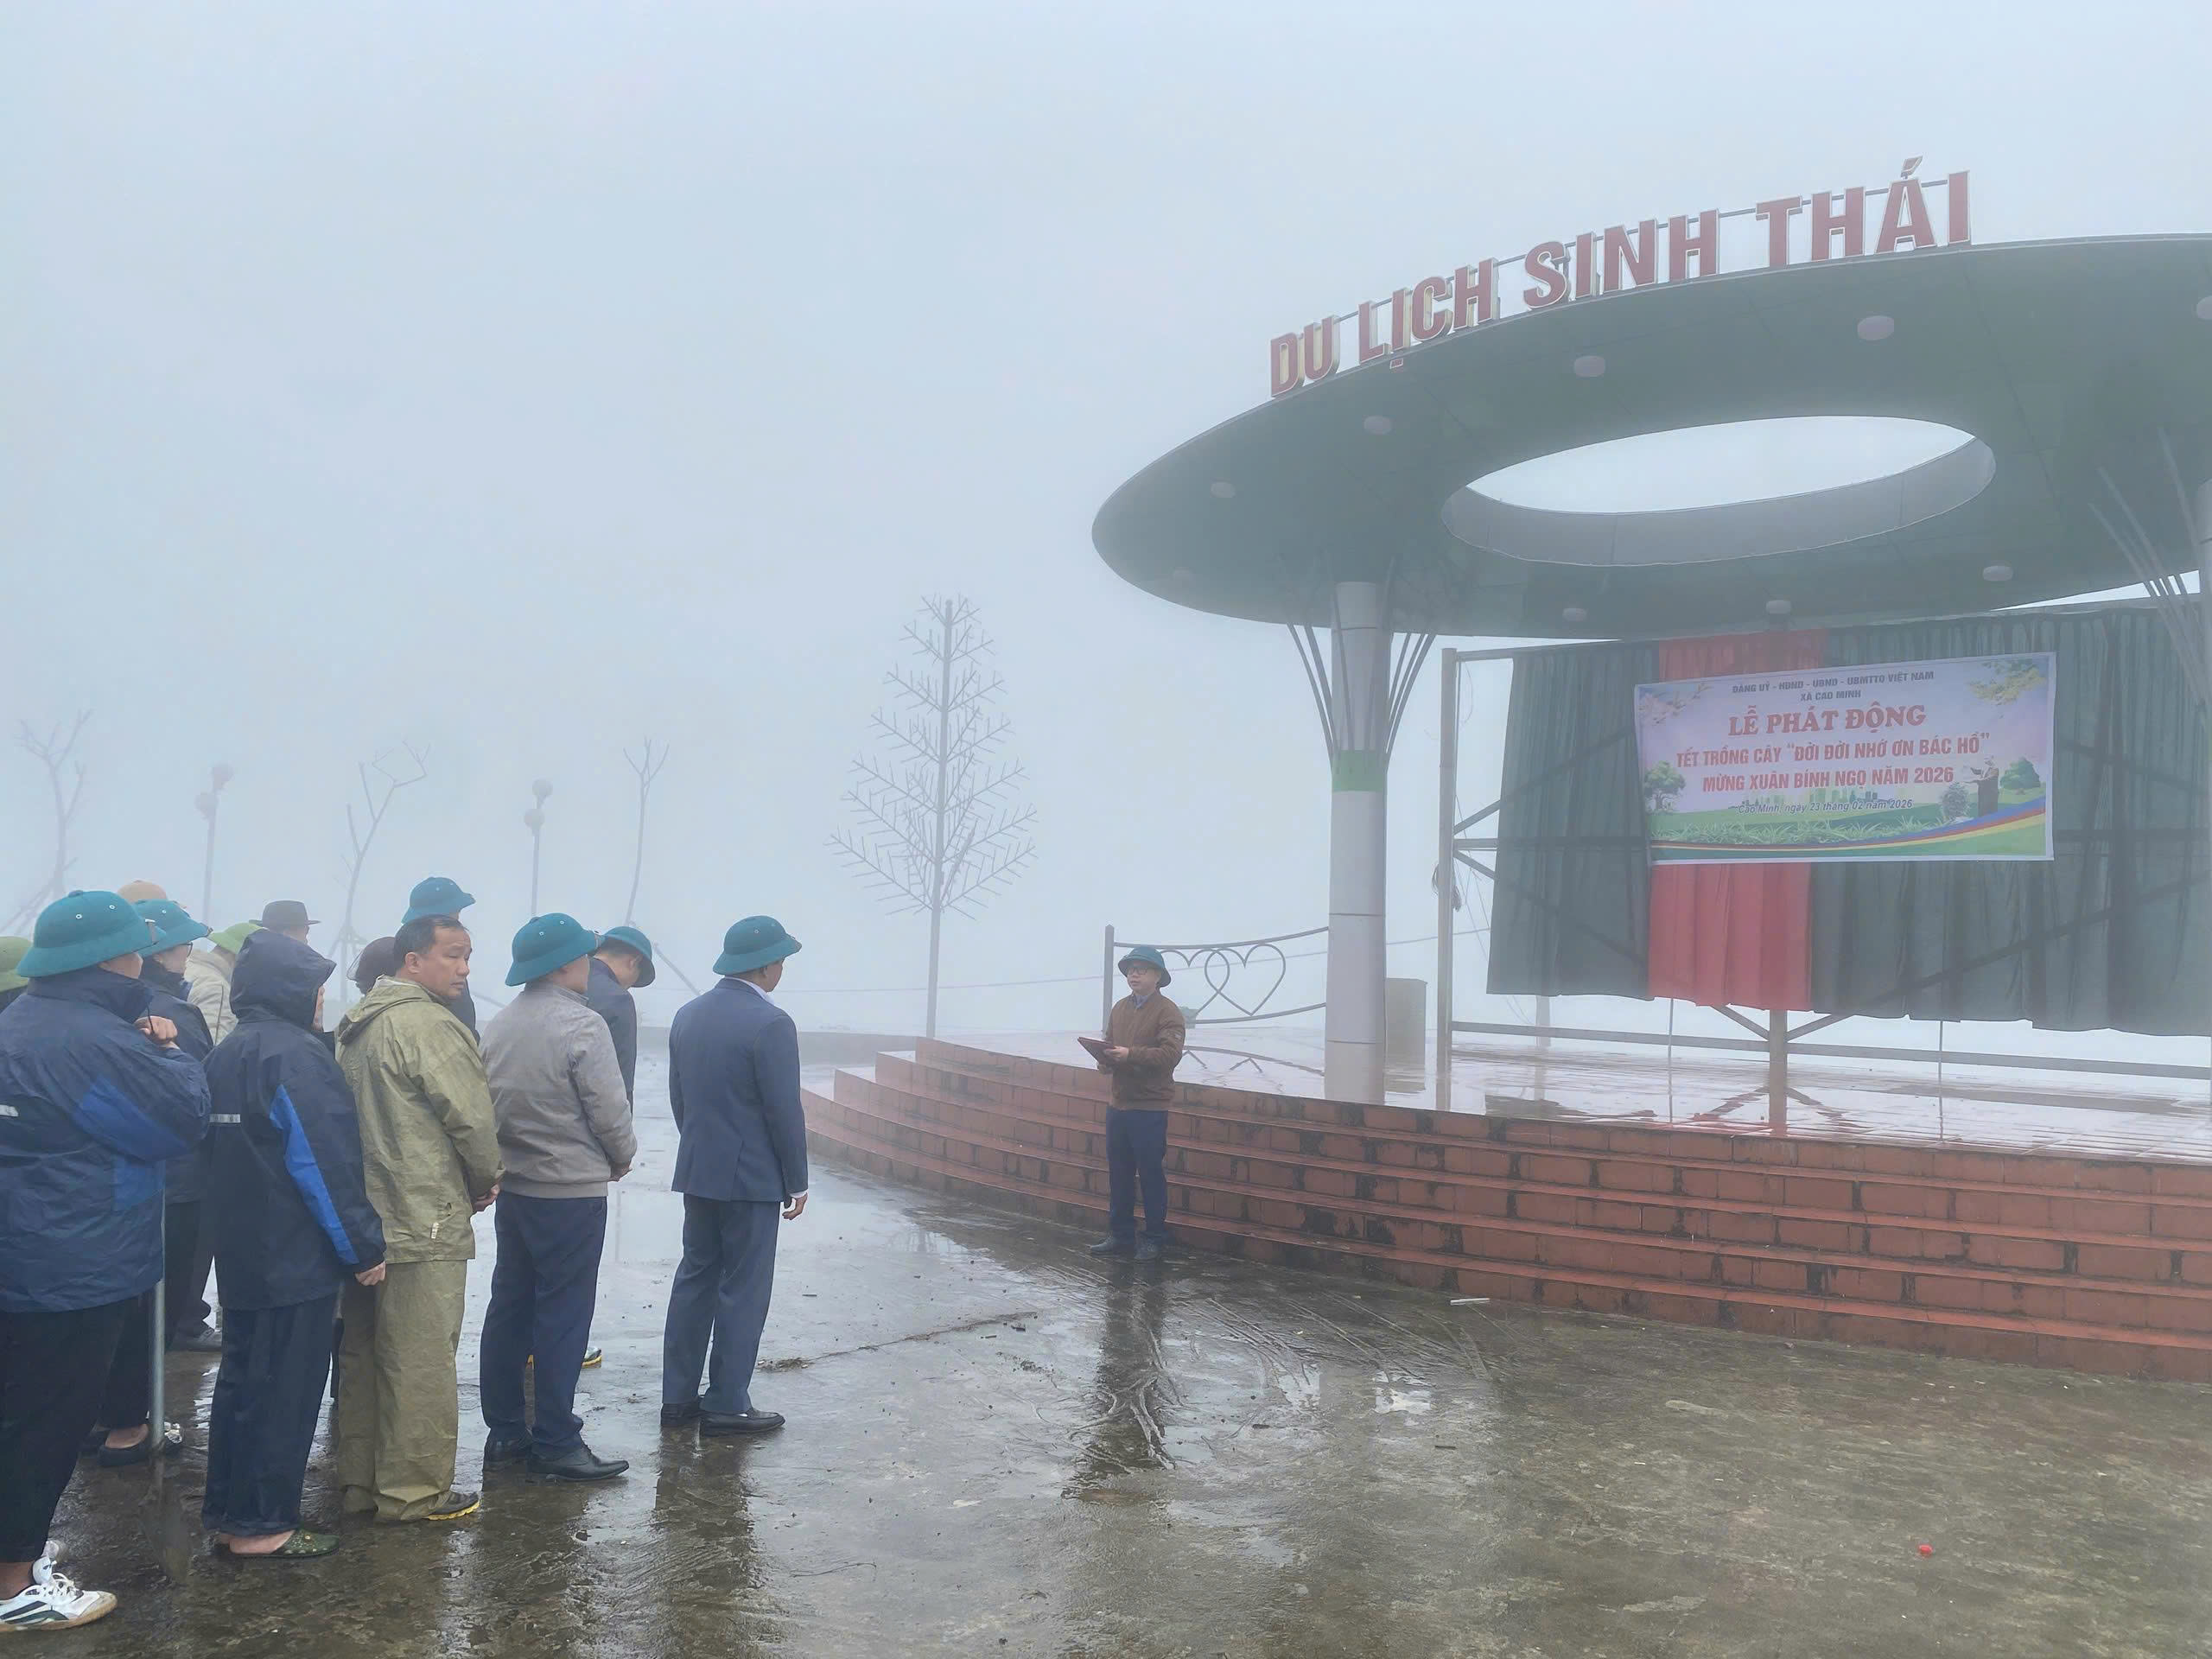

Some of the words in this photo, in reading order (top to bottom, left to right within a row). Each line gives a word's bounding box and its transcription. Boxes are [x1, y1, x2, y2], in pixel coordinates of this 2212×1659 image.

[1270, 315, 1339, 397] DU
[1359, 257, 1500, 369] LỊCH
[1522, 208, 1721, 310] SINH
[1756, 156, 1971, 268] THÁI
[1812, 677, 1838, 688] UBND
[1887, 671, 1908, 683] VIỆT
[1910, 671, 1935, 681] NAM
[1815, 690, 1834, 701] CAO
[1836, 689, 1861, 700] MINH
[1727, 704, 1759, 736] LỄ
[1765, 705, 1840, 734] PHÁT
[1845, 701, 1927, 734] ĐỘNG
[1675, 747, 1700, 768] TẾT
[1702, 744, 1750, 766] TRỒNG
[1753, 745, 1783, 765] CÂY
[1824, 741, 1850, 760] ĐỜI
[1854, 739, 1888, 759] NHỚ
[1891, 739, 1914, 756] ƠN
[1919, 734, 1952, 755] BÁC
[1702, 772, 1745, 792] MỪNG
[1749, 771, 1789, 790] XUÂN
[1794, 769, 1830, 788] BÍNH
[1834, 769, 1866, 790] NGỌ
[1872, 766, 1909, 785] NĂM
[1914, 766, 1955, 784] 2026
[1738, 804, 1756, 814] Cao
[1810, 802, 1820, 811] 23
[1852, 800, 1864, 810] 02
[1890, 798, 1913, 810] 2026
